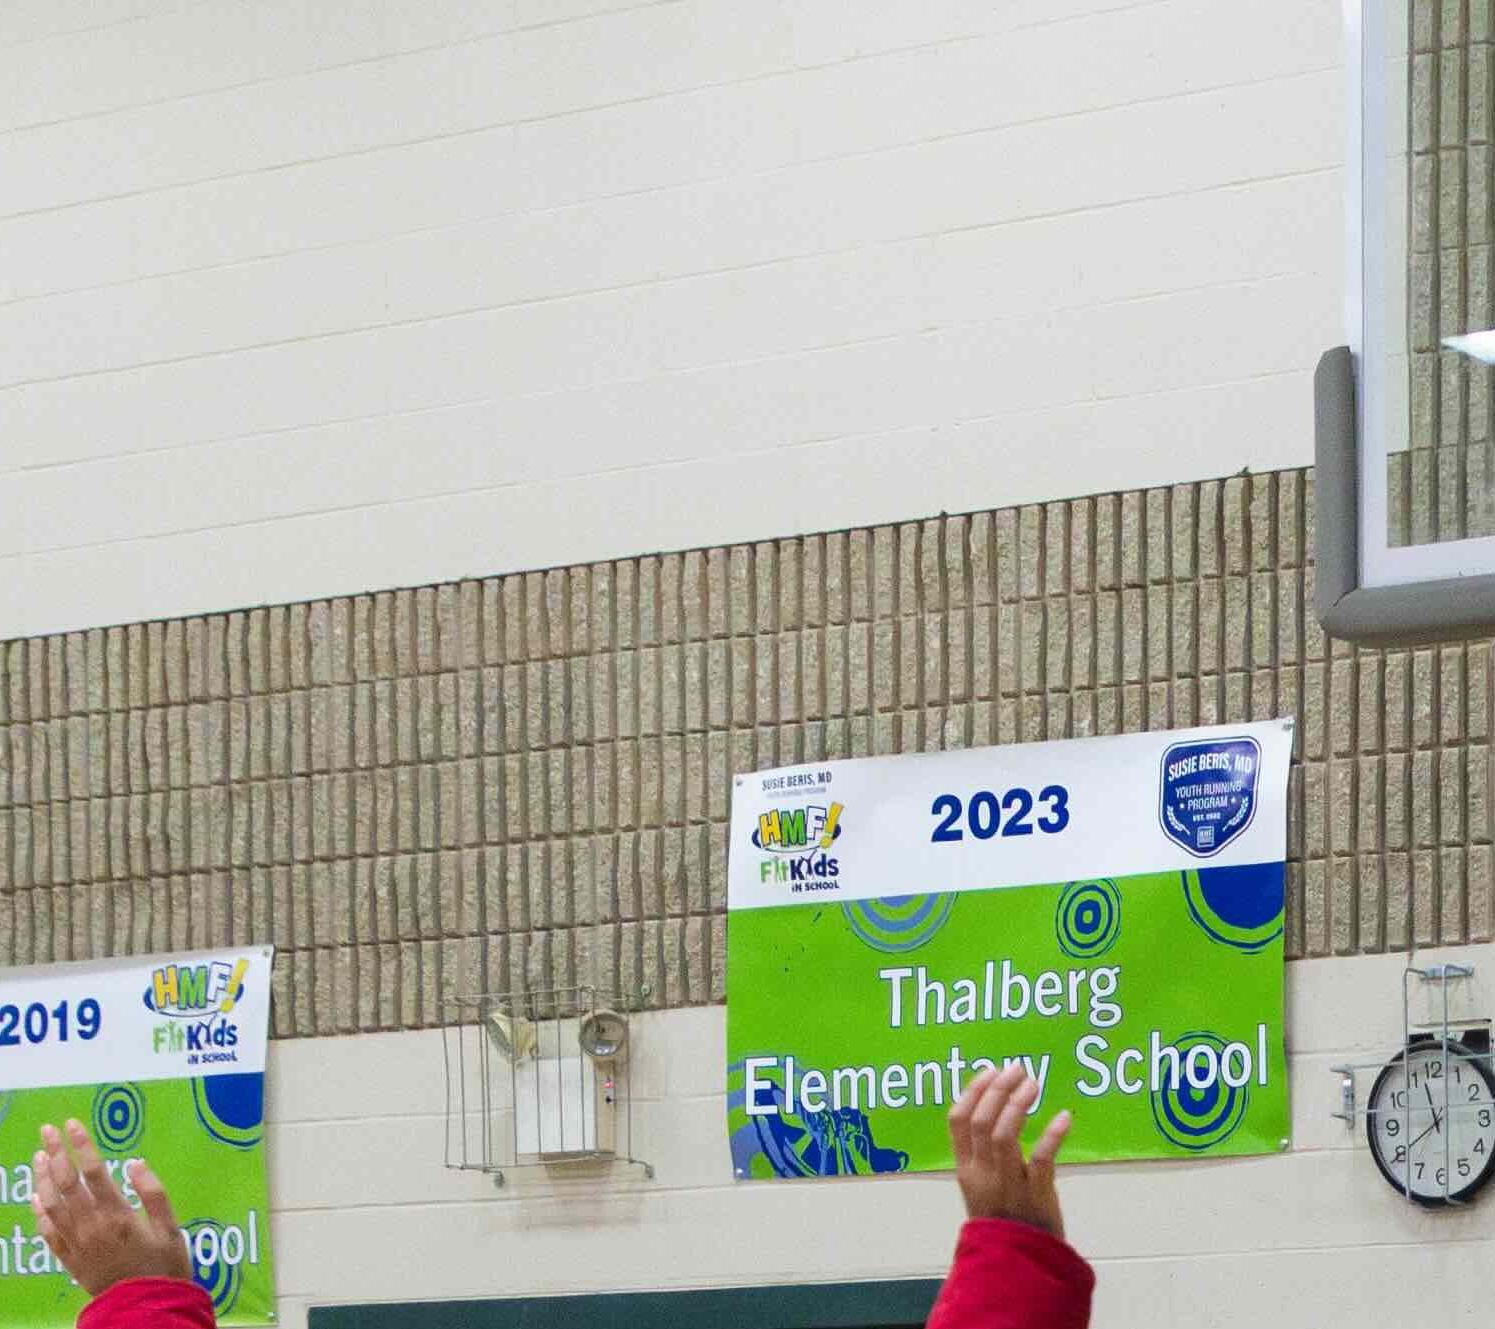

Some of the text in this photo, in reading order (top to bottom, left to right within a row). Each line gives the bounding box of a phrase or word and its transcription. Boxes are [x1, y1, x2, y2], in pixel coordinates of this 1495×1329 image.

[1168, 756, 1198, 782] SUSIE
[1234, 755, 1252, 775] MD
[762, 777, 784, 791] SUSIE
[818, 771, 832, 783] MD
[1175, 780, 1241, 798] YOUTH RUNNING
[1187, 796, 1228, 810] PROGRAM
[931, 785, 1069, 842] 2023
[759, 802, 843, 849] HMF!
[153, 958, 250, 1013] HMF!
[879, 960, 1122, 1028] Thalberg
[1075, 1023, 1268, 1096] School
[1425, 1060, 1443, 1078] 12
[1455, 1067, 1461, 1083] 1
[1391, 1091, 1407, 1109] 10
[1468, 1083, 1480, 1102] 2
[1478, 1109, 1491, 1127] 3
[1386, 1119, 1400, 1137] 9
[1394, 1146, 1407, 1163] 8
[1473, 1138, 1485, 1155] 4
[1414, 1162, 1426, 1180] 7
[1457, 1158, 1471, 1177] 5
[1435, 1168, 1447, 1186] 6
